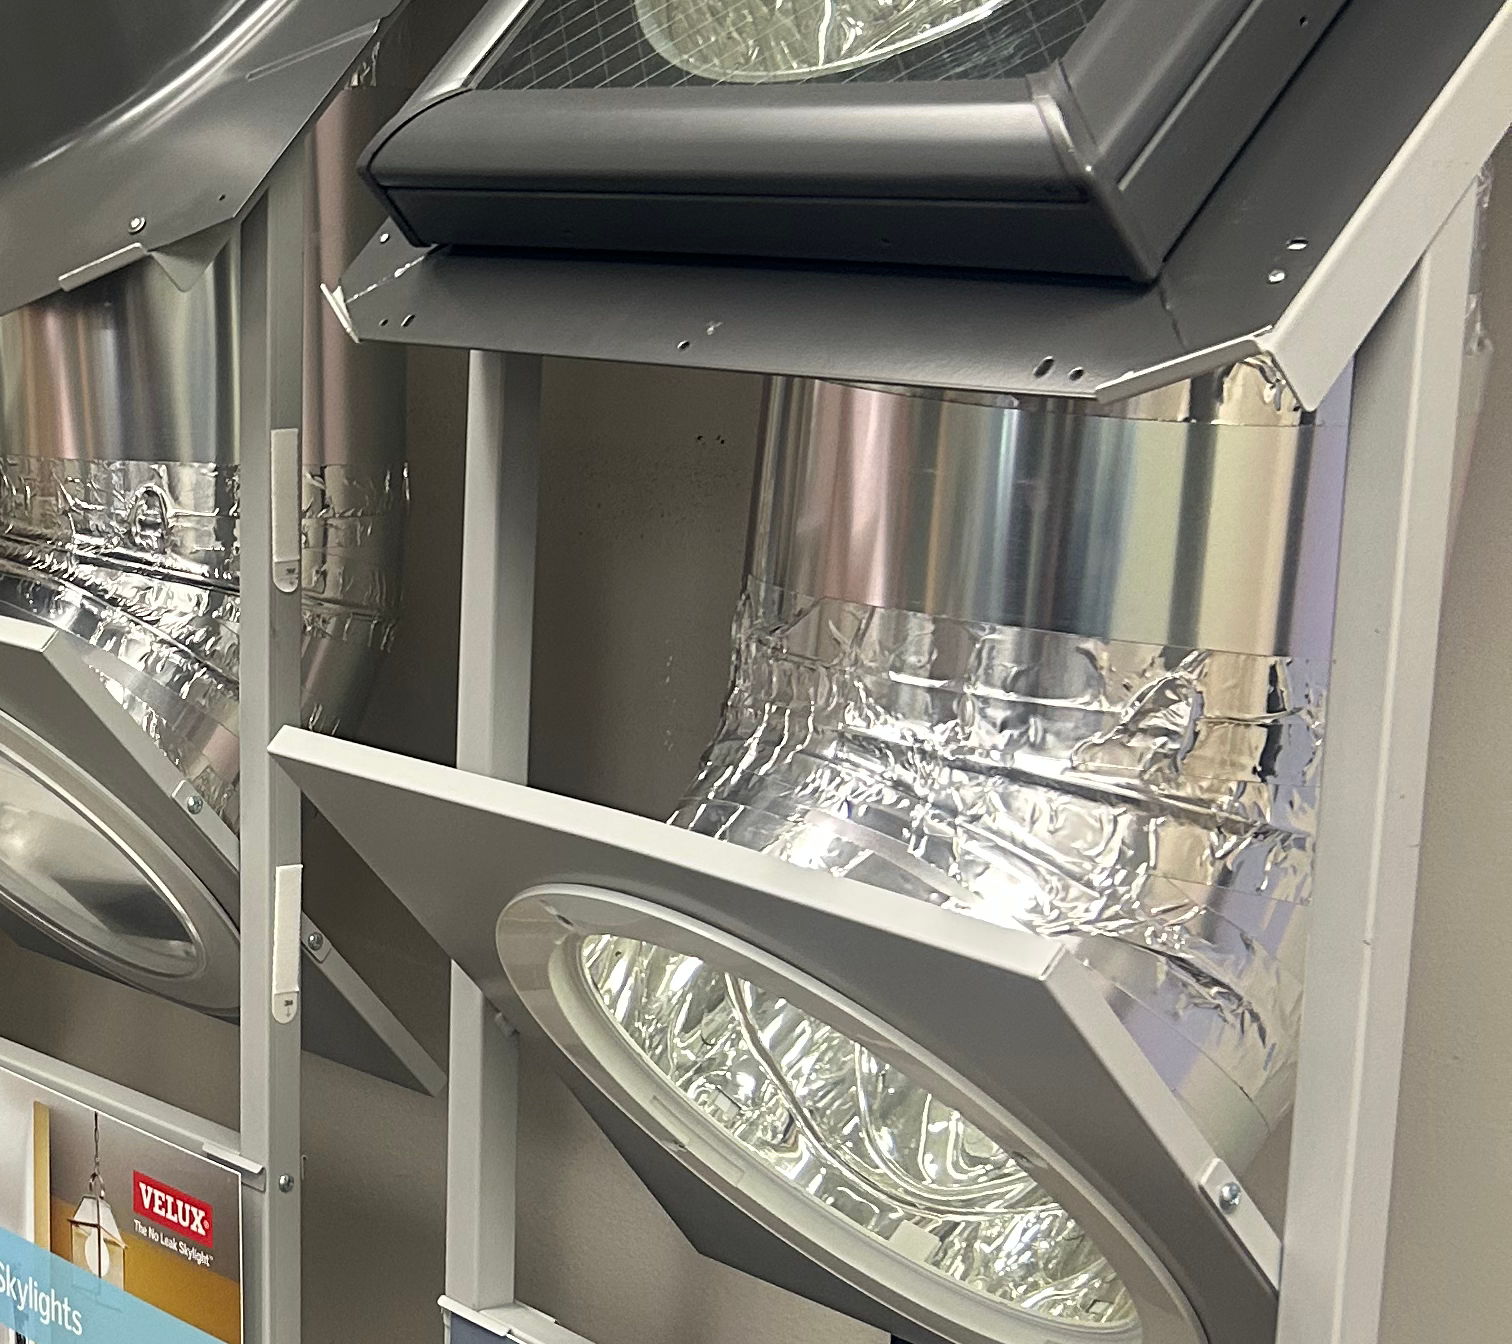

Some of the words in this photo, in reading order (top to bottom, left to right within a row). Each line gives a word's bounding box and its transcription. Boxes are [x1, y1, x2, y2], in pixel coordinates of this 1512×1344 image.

[138, 1181, 206, 1236] VELUX
[133, 1219, 148, 1237] The
[148, 1226, 159, 1242] No
[160, 1231, 178, 1252] Leak
